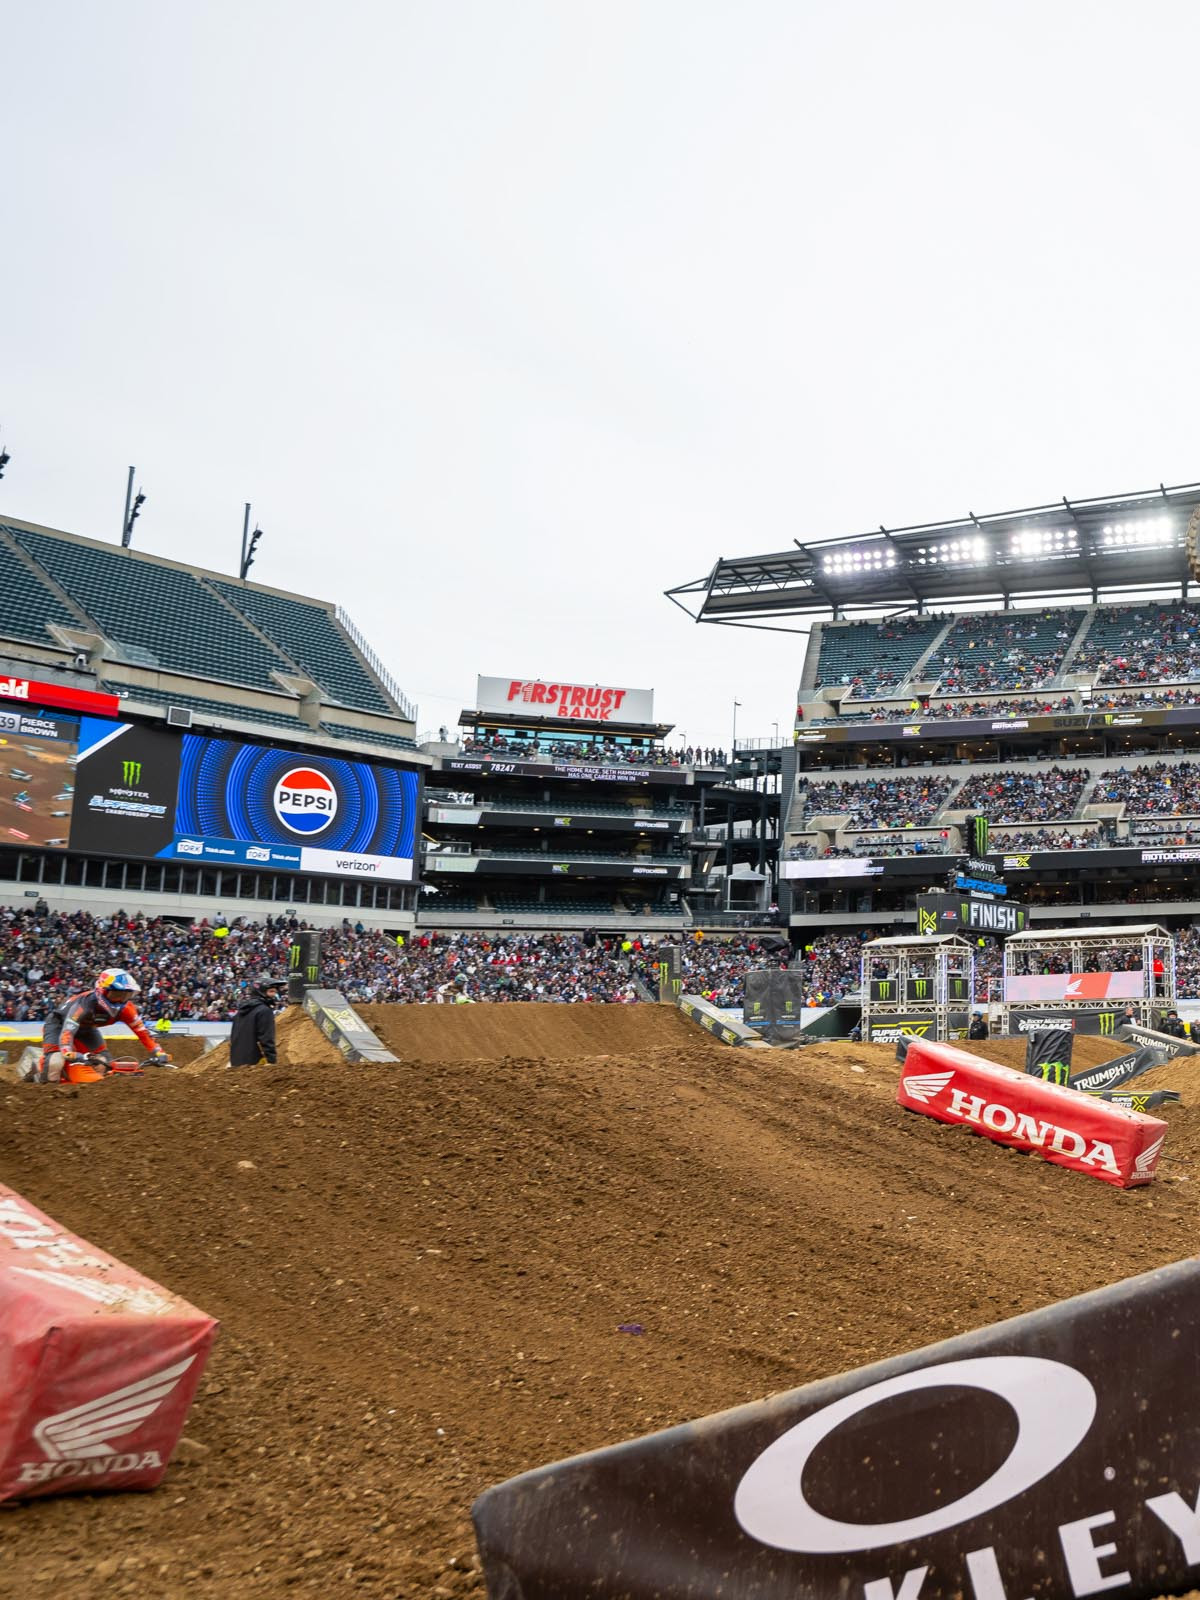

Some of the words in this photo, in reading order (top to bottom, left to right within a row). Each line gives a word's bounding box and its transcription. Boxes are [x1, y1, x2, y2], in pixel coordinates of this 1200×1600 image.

[557, 705, 613, 720] BANK
[21, 717, 56, 729] PIERCE
[20, 726, 58, 737] BROWN
[490, 763, 516, 772] 78247
[279, 791, 333, 811] PEPSI
[179, 844, 200, 854] TORK
[249, 850, 268, 860] TORK
[335, 859, 377, 872] verizon
[968, 859, 996, 873] MONSTER
[970, 902, 1016, 931] FINISH
[871, 1029, 903, 1037] SUPER
[1132, 1033, 1171, 1052] TRIUMPH
[1074, 1064, 1126, 1091] TRIUMPH
[946, 1088, 1122, 1176] HONDA
[1131, 1170, 1155, 1179] HONDA
[17, 1450, 163, 1484] HONDA
